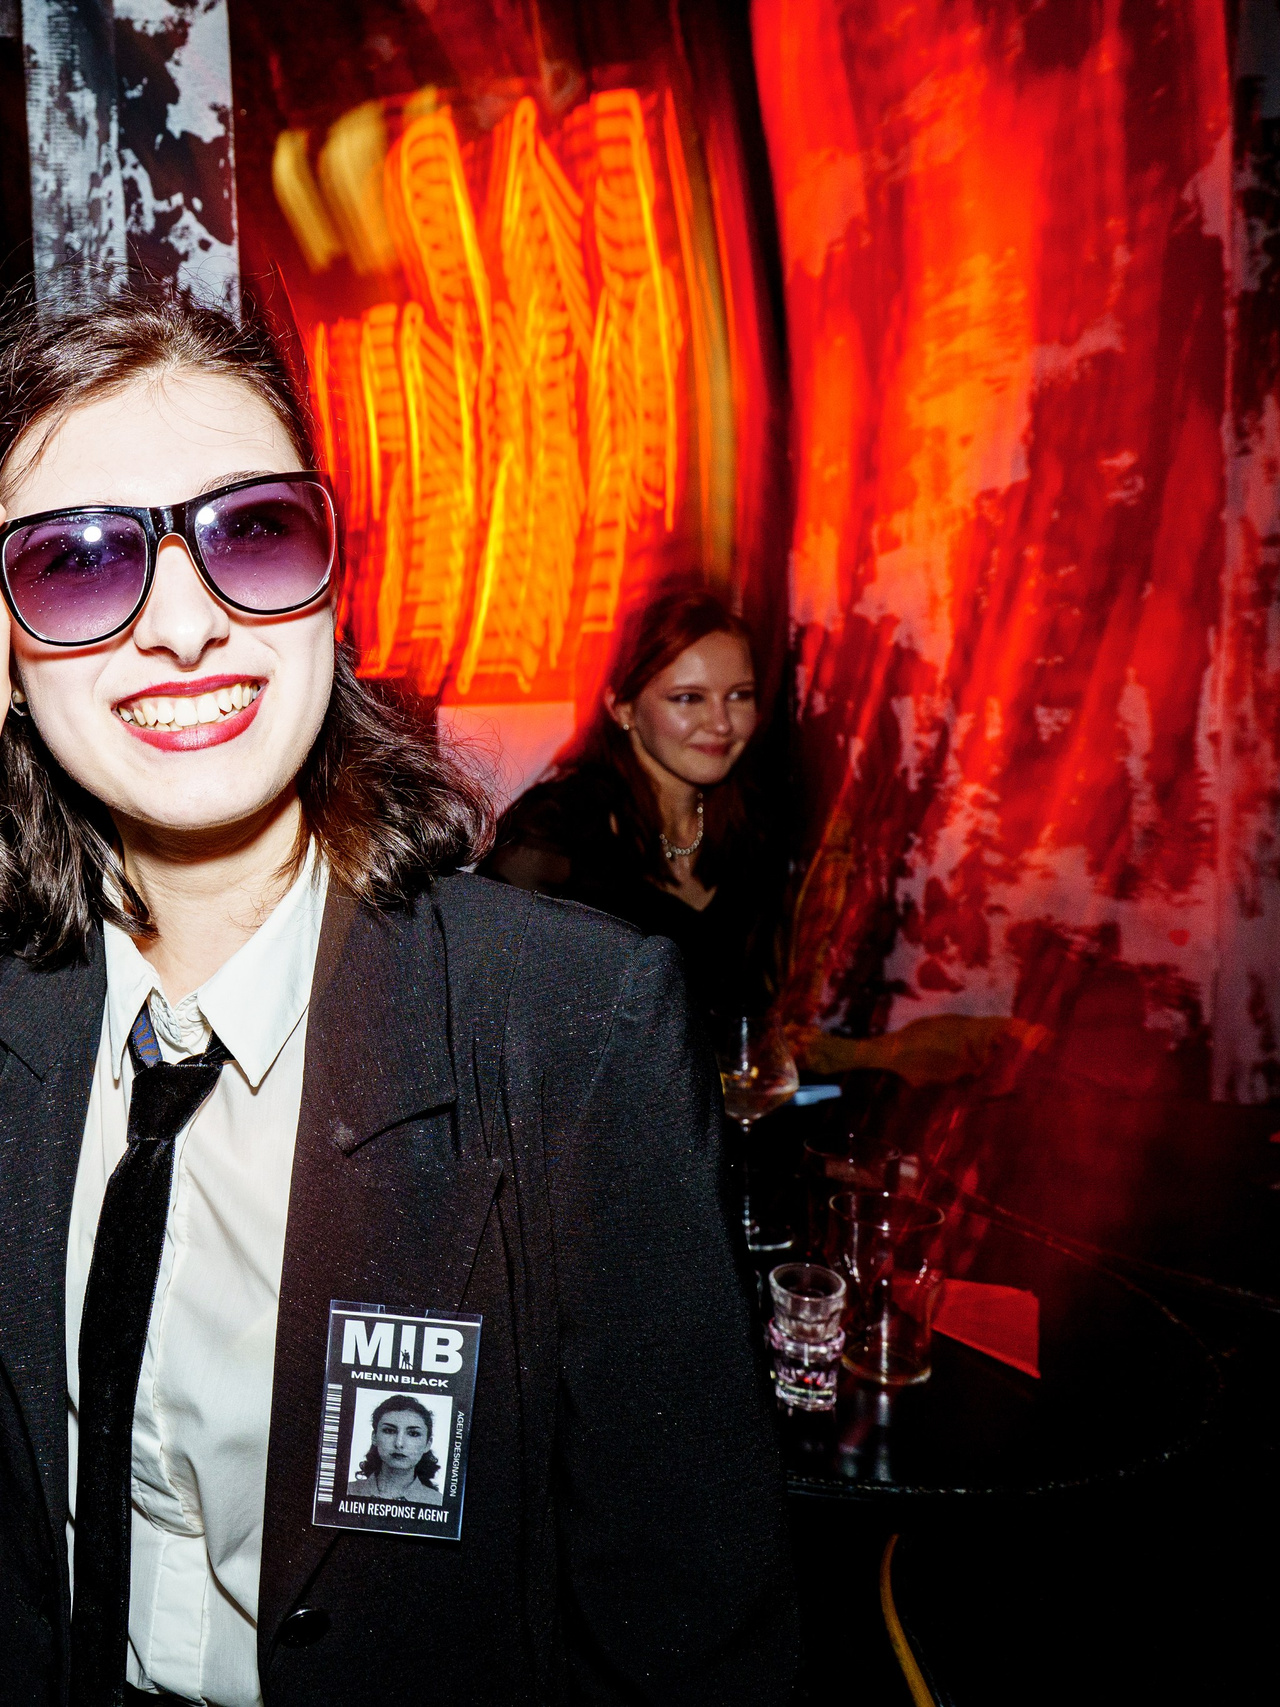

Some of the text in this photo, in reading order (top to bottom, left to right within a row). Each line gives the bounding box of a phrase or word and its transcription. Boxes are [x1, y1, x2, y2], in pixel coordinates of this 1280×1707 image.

[341, 1319, 464, 1374] MIB
[351, 1371, 449, 1388] MEN IN BLACK
[449, 1410, 465, 1497] AGENT DESIGNATION
[338, 1500, 450, 1523] ALIEN RESPONSE AGENT
